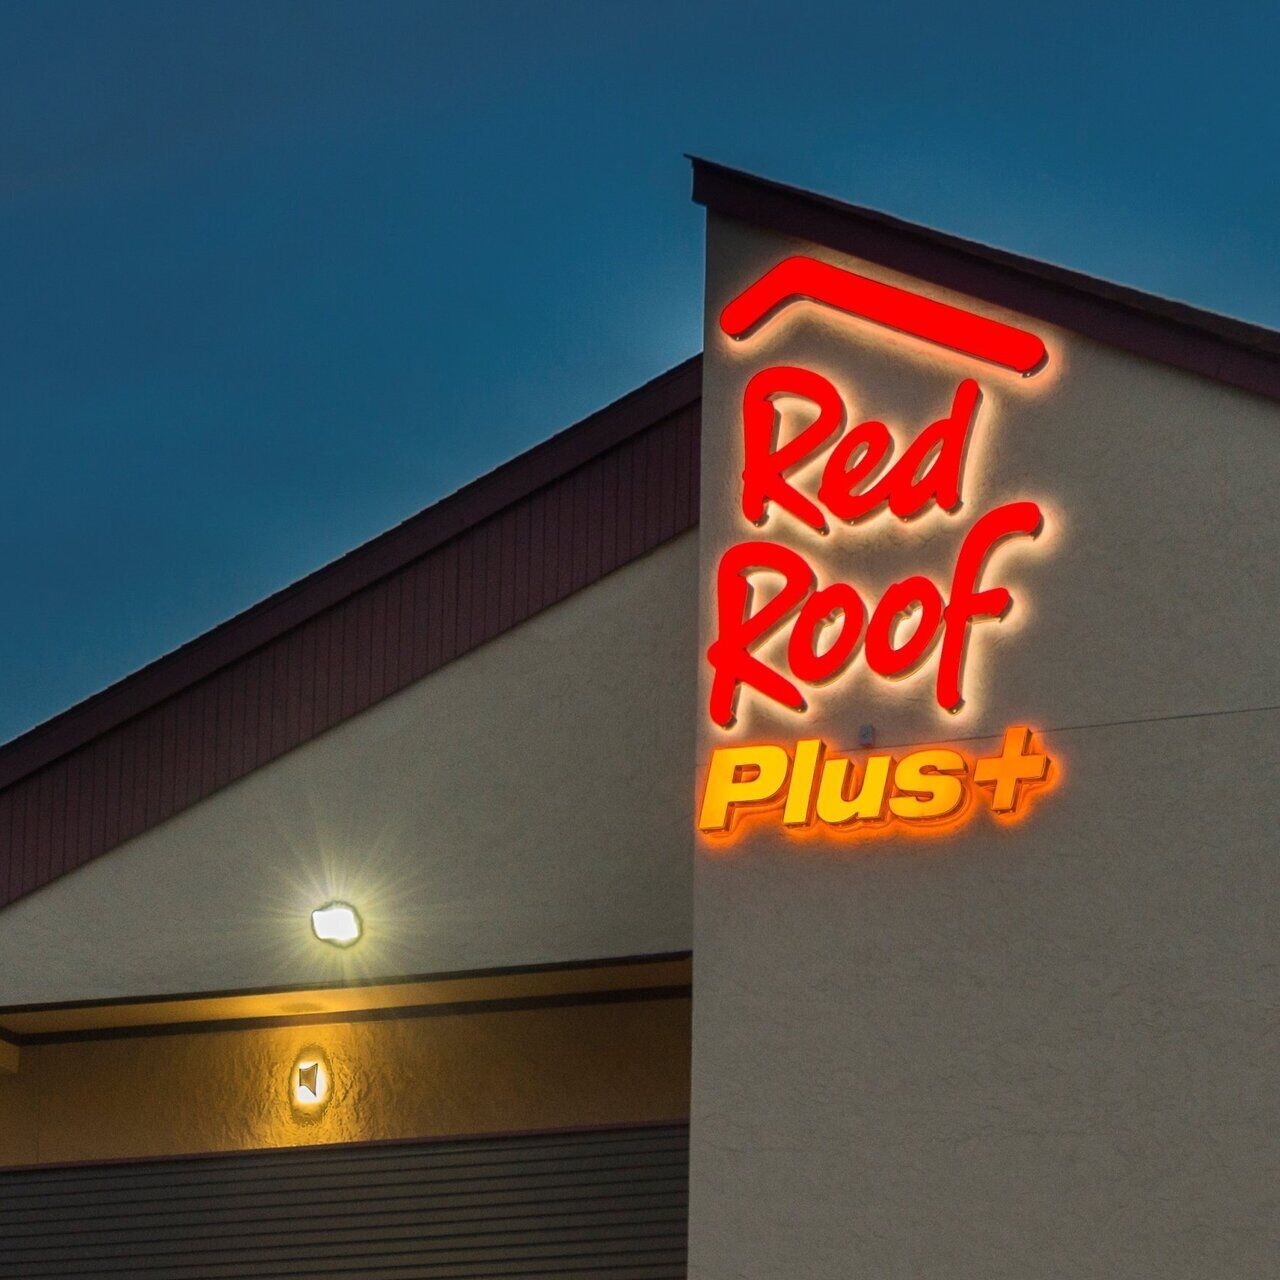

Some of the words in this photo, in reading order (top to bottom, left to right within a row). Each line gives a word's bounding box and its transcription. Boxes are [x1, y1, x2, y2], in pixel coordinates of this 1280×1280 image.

[742, 366, 980, 533] Red
[707, 502, 1042, 728] Roof
[698, 727, 1050, 832] Plus+
